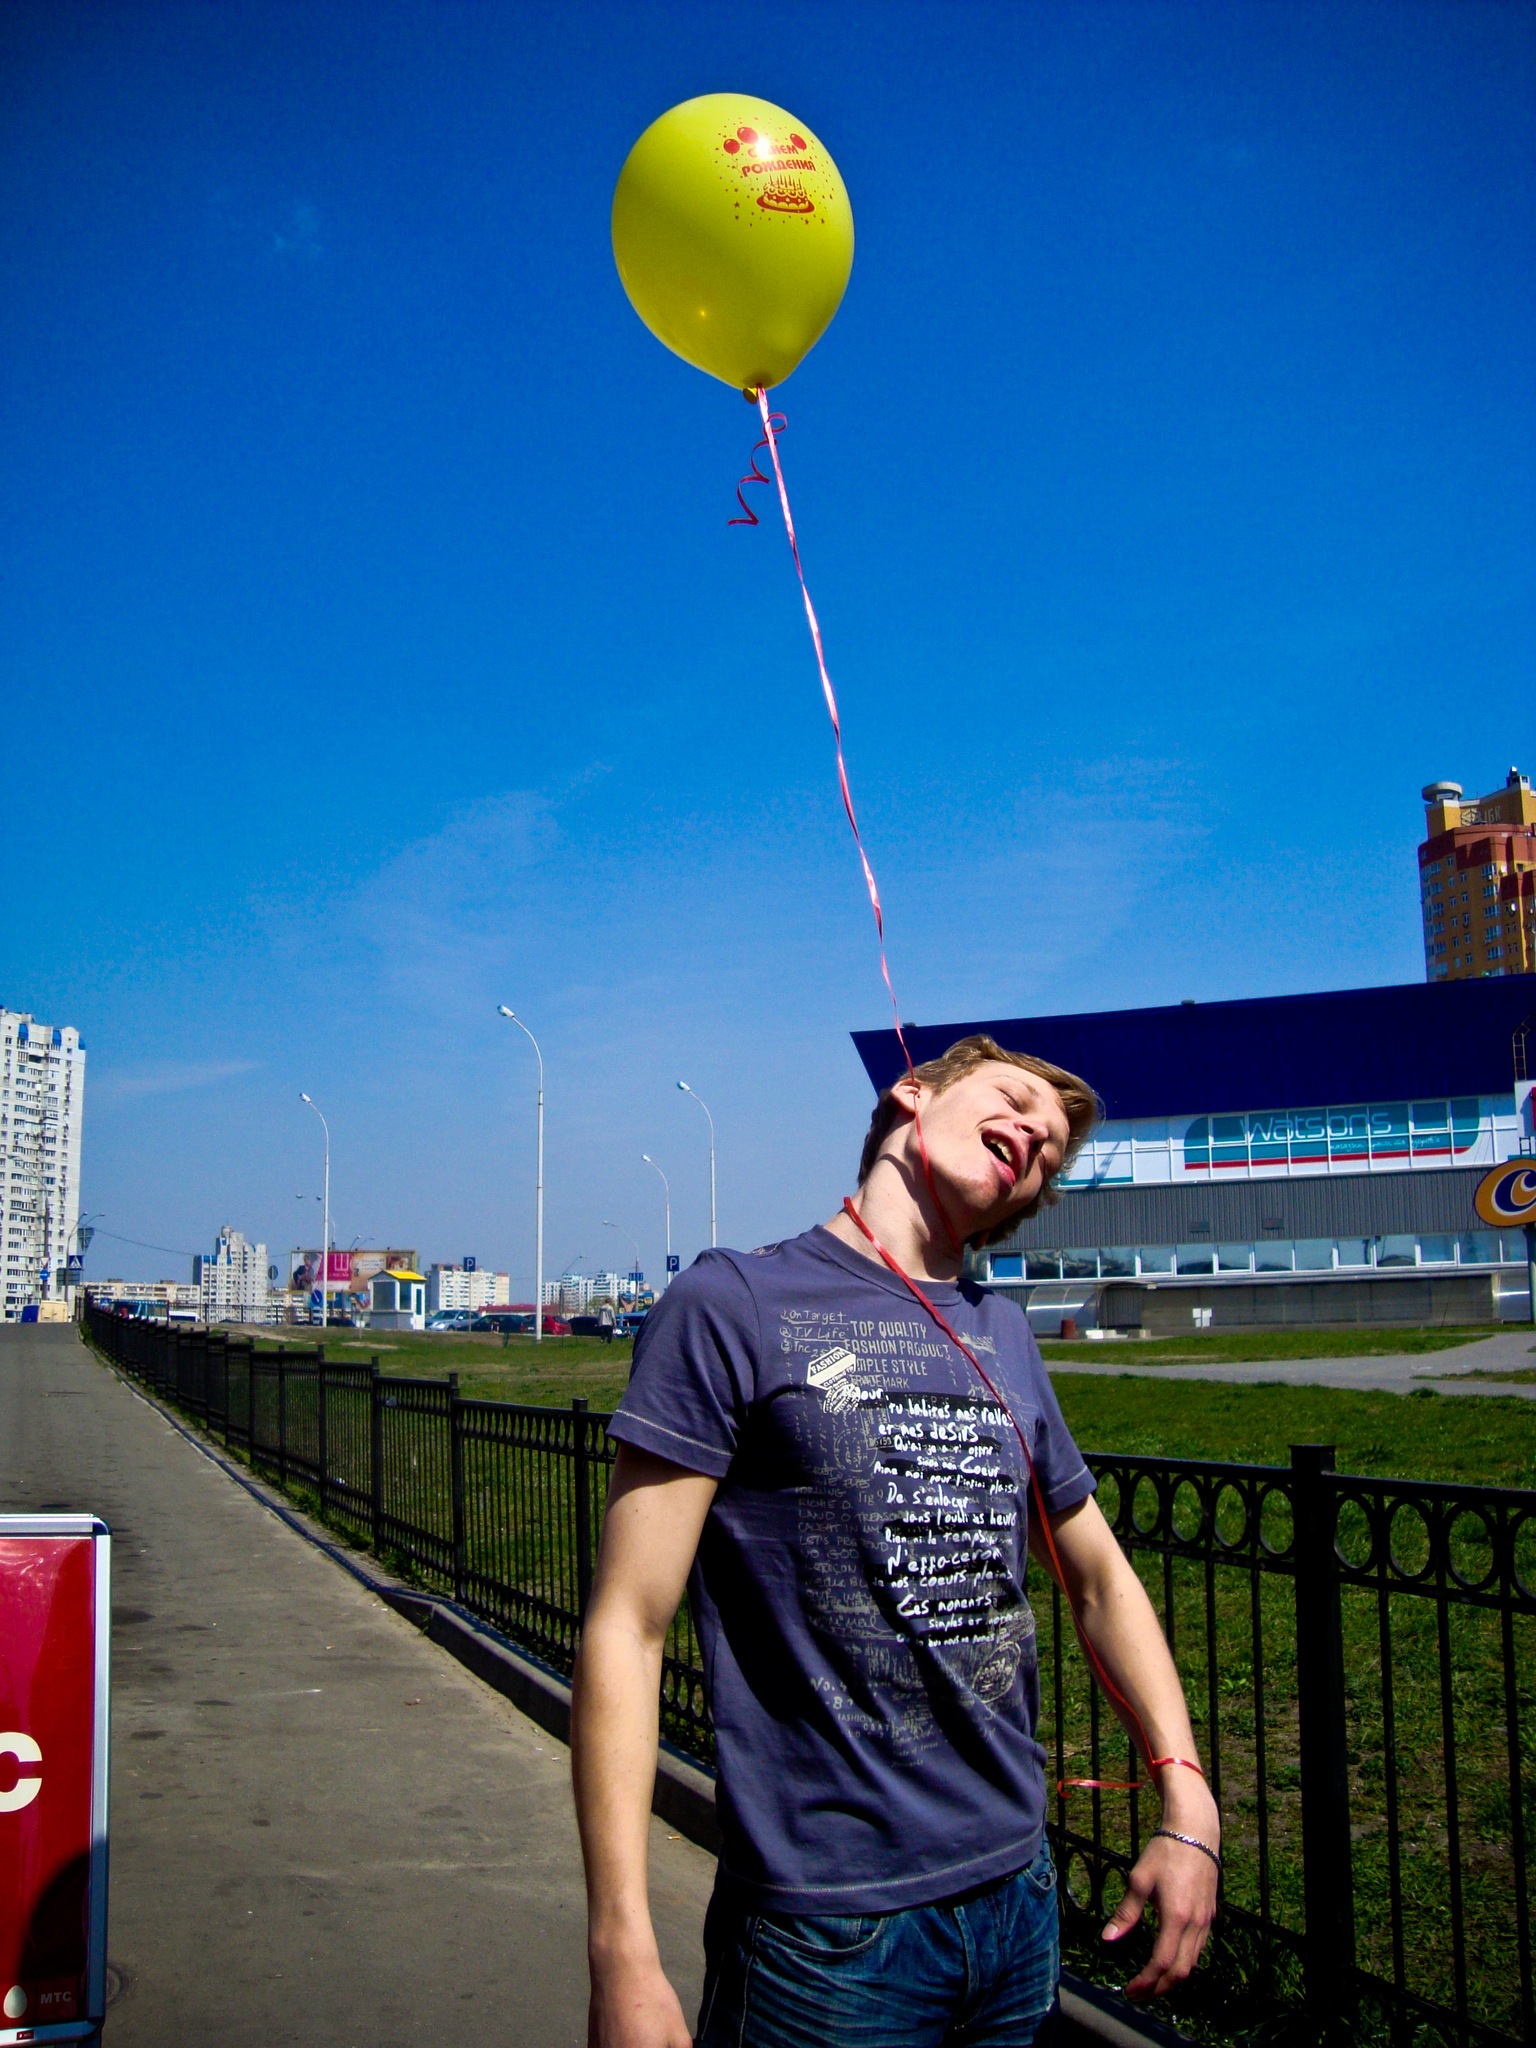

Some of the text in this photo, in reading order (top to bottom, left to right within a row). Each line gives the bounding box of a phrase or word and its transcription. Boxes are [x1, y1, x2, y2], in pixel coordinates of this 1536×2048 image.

[742, 160, 816, 177] РОЖДЕНИЯ
[850, 1321, 926, 1339] TOP QUALITY
[844, 1339, 897, 1355] FASHION
[811, 1350, 846, 1374] FASHION
[891, 1360, 928, 1376] STYLE
